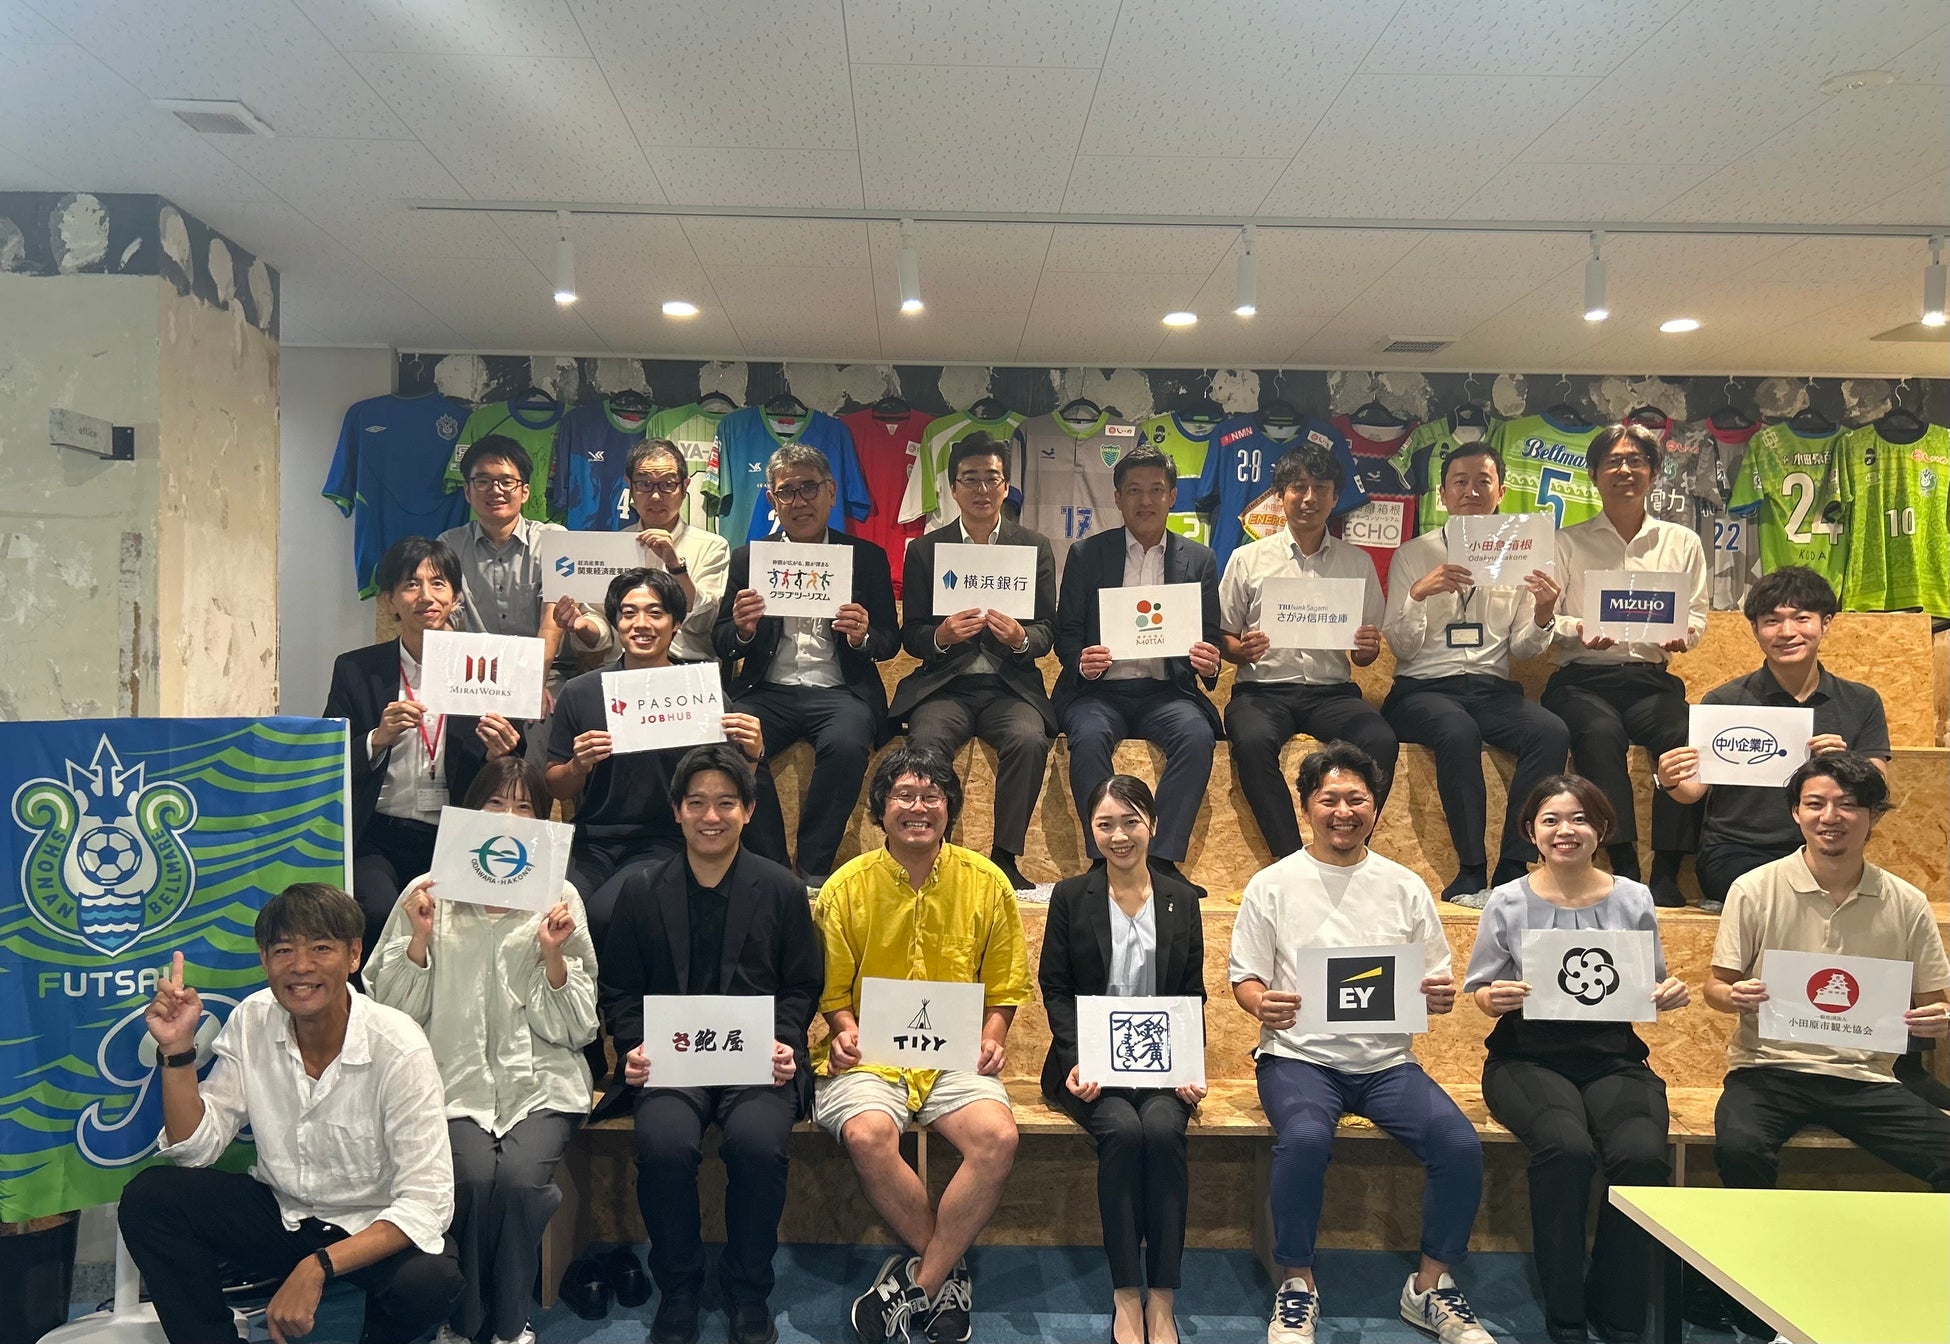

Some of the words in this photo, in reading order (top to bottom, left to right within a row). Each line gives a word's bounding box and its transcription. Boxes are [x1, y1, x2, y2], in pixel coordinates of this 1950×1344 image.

[1231, 426, 1253, 441] NMN
[1237, 449, 1262, 483] 28
[1535, 465, 1573, 530] 5
[1644, 488, 1686, 513] 電力
[1061, 505, 1094, 540] 17
[1344, 521, 1400, 541] ECHO
[1885, 507, 1917, 538] 10
[1714, 521, 1742, 552] 22
[1499, 553, 1528, 561] akone
[963, 574, 1028, 592] 横浜銀行
[1609, 598, 1665, 611] MIZUHO
[1277, 612, 1348, 624] さがみ信用金庫
[638, 692, 717, 710] PASONA
[1715, 736, 1774, 753] 中小企業庁
[36, 829, 75, 919] SHONAN
[148, 829, 183, 916] BELLMARE
[1339, 986, 1376, 1009] EY
[1788, 1017, 1873, 1036] 小田原市観光協会
